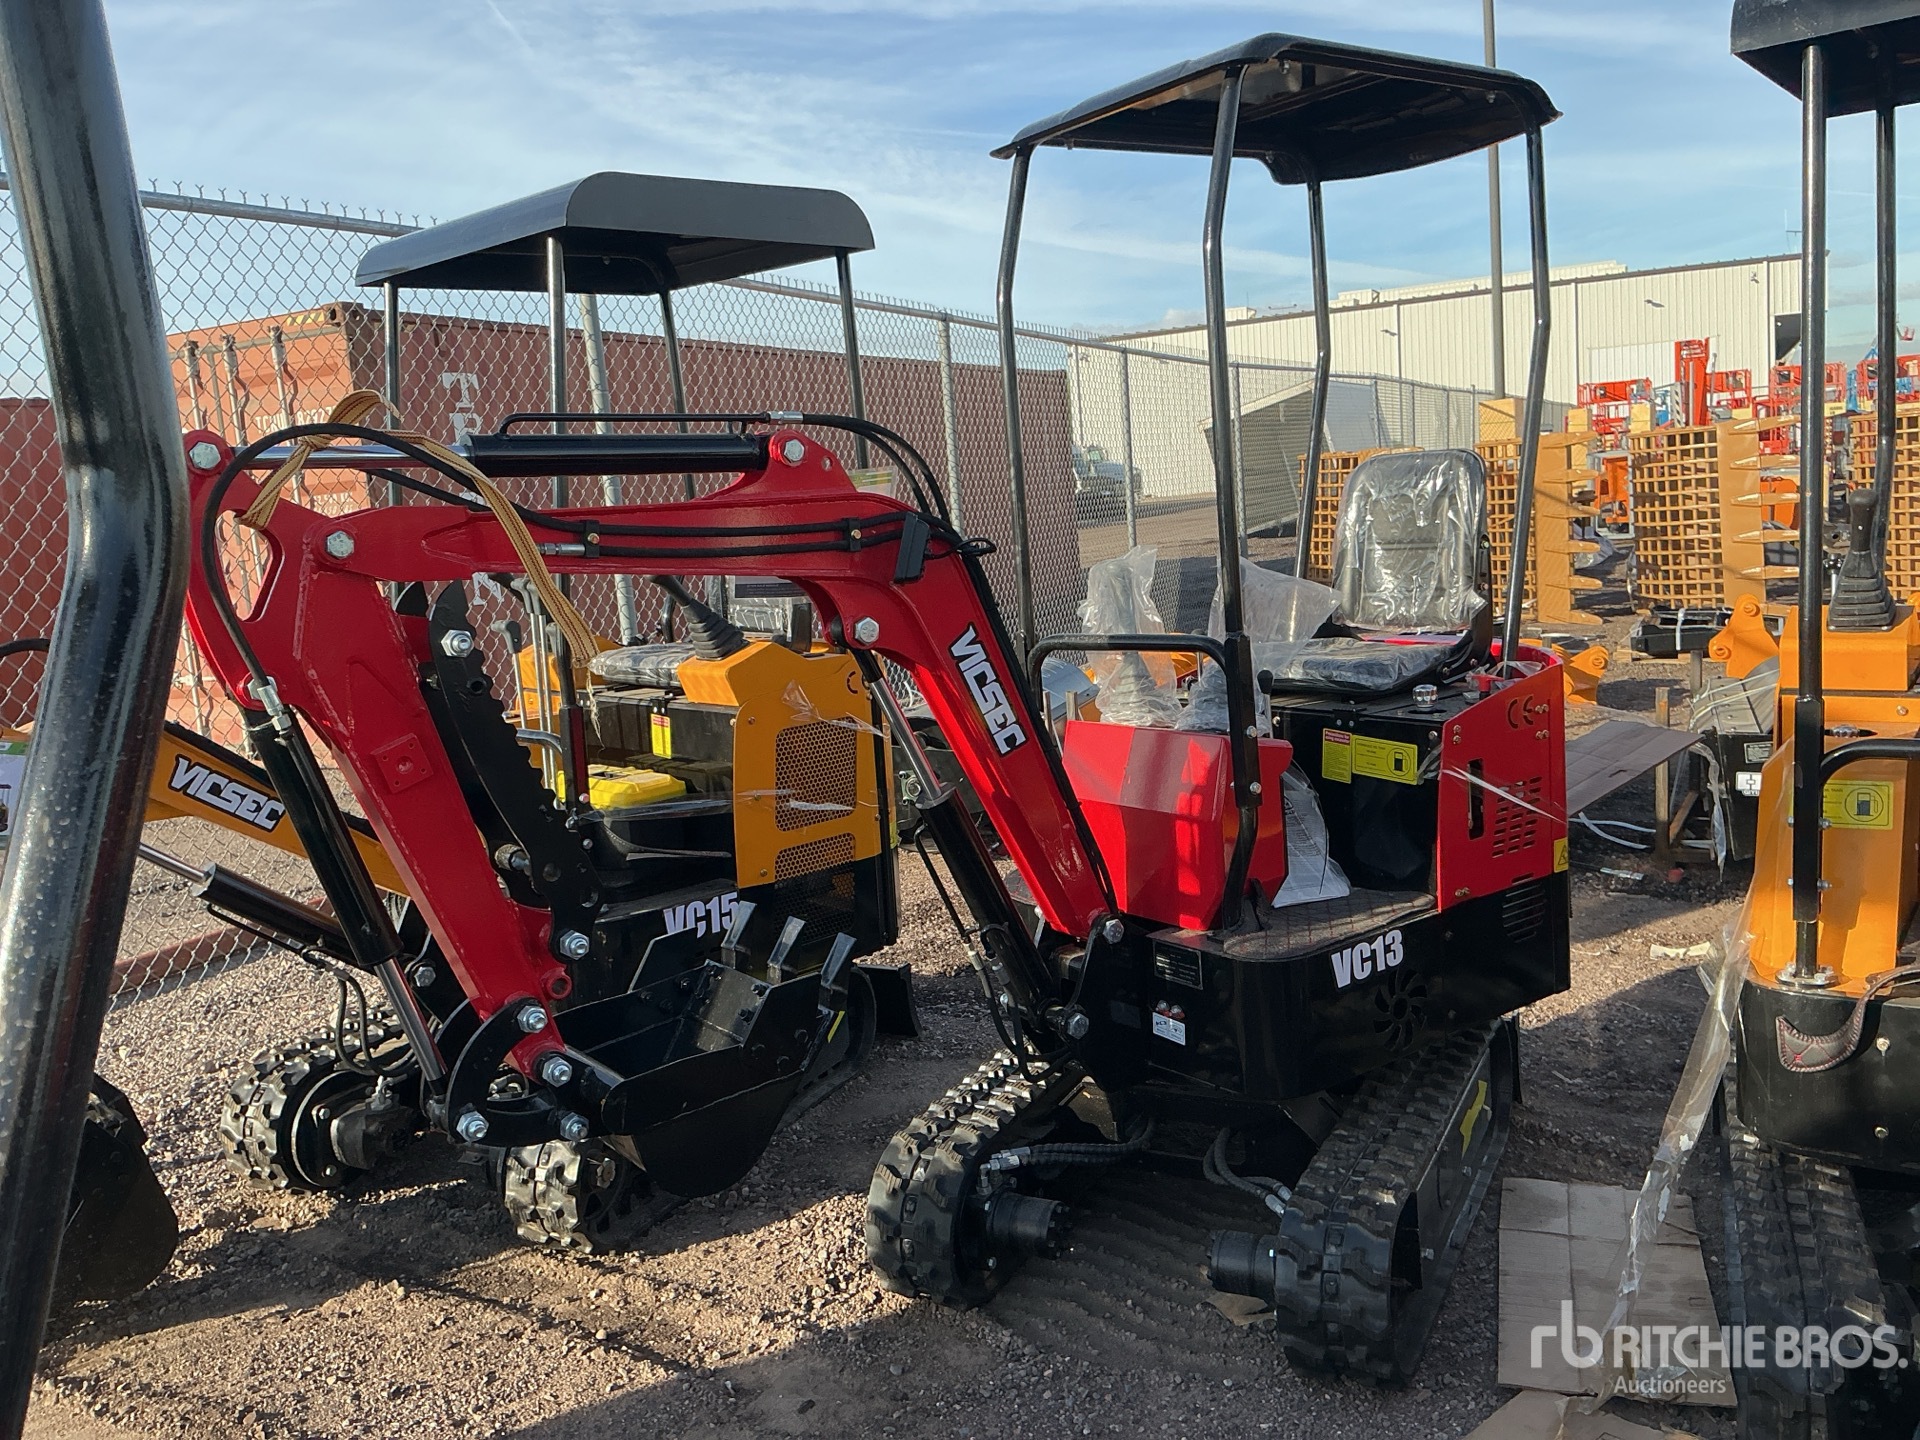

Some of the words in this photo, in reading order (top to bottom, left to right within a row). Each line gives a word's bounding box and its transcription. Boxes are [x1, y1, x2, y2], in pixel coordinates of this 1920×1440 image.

[951, 625, 1026, 754] VICSEC
[171, 757, 285, 829] VICSEC
[663, 892, 738, 938] VC15
[1331, 929, 1404, 988] VC13
